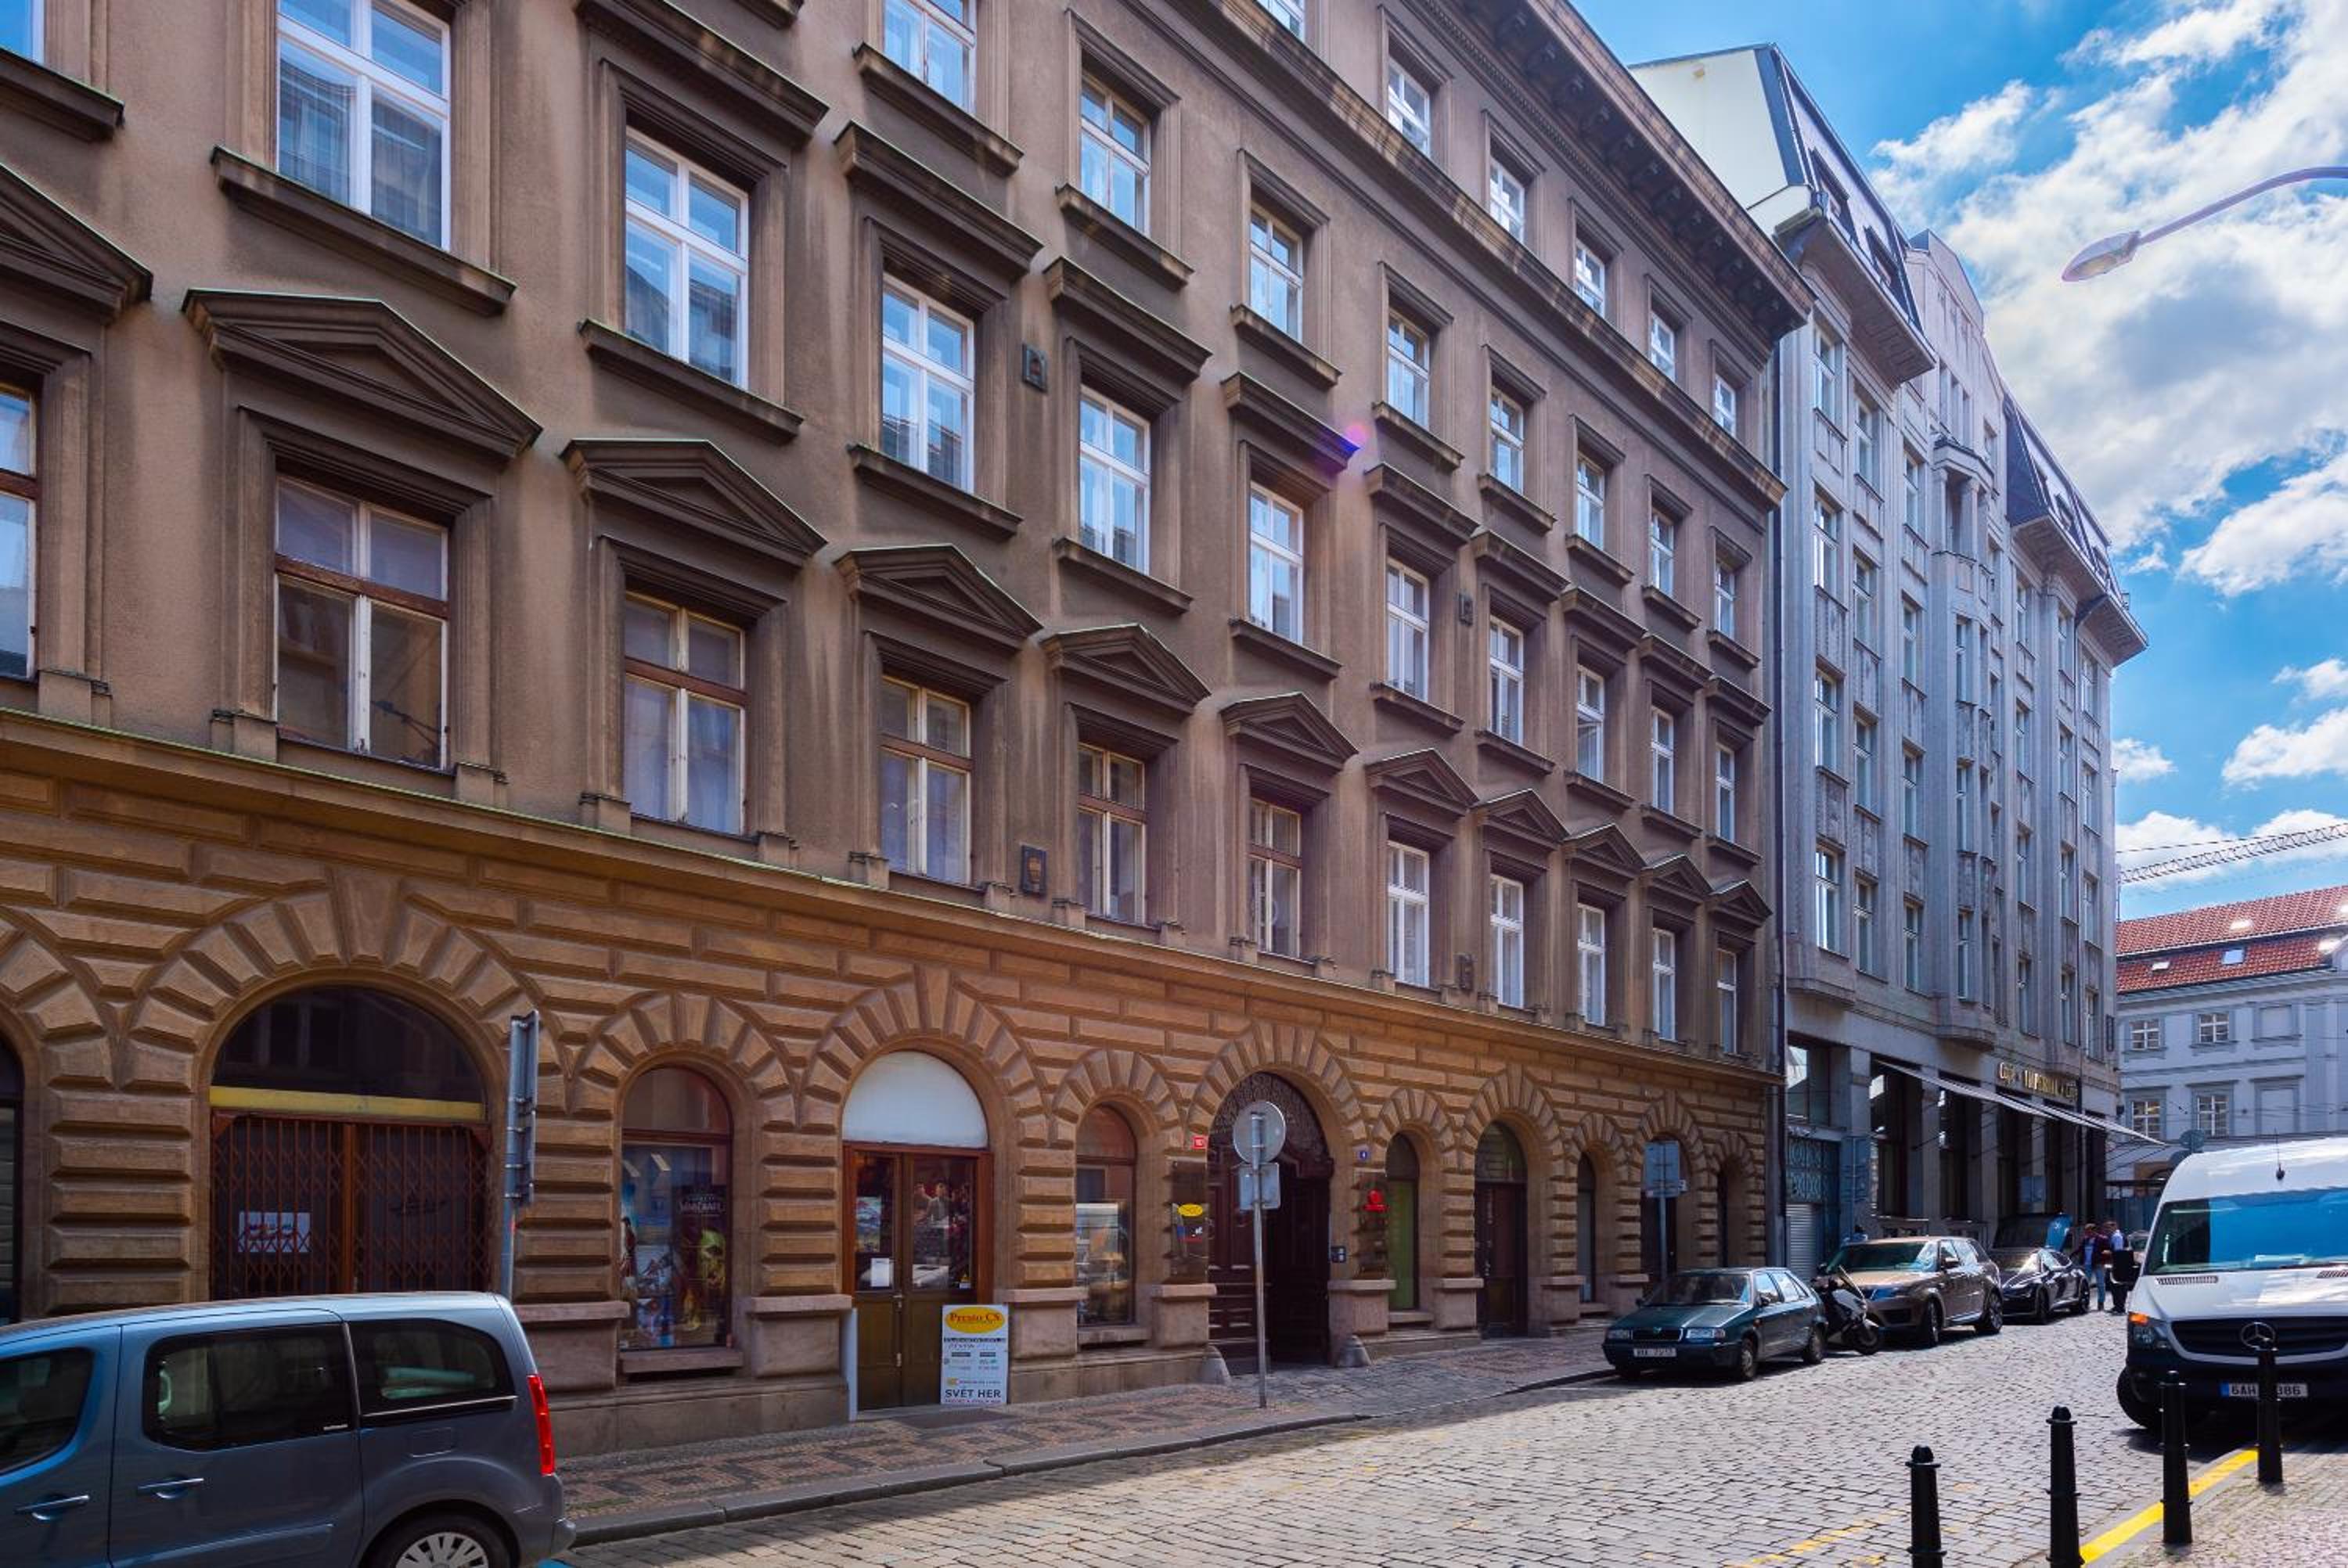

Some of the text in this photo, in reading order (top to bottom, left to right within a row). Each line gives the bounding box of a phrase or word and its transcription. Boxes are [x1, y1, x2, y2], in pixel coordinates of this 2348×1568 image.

[978, 1389, 1002, 1398] HER
[2231, 1385, 2301, 1395] 6AH 386
